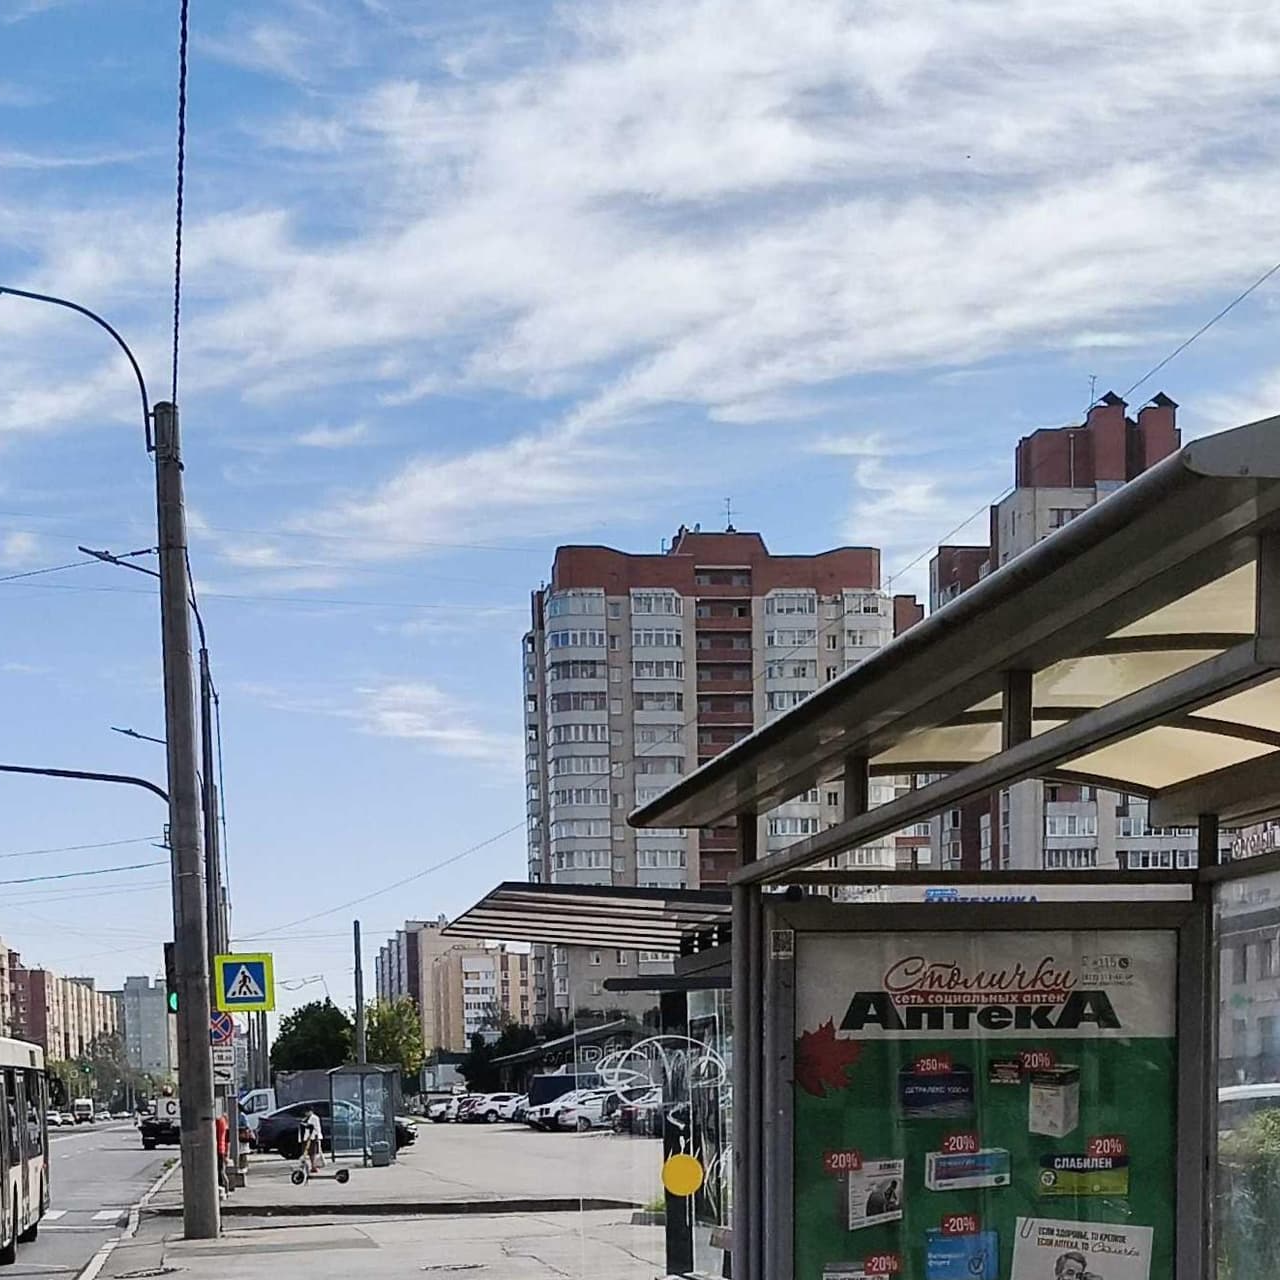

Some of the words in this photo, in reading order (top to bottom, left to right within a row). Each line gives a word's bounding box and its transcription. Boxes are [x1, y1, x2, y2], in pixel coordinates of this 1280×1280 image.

[883, 956, 1078, 990] Столички
[895, 993, 924, 1004] сеть
[927, 993, 1020, 1004] социальных
[1023, 992, 1066, 1003] аптек
[916, 1058, 937, 1072] -250
[944, 1135, 975, 1151] -20%
[1090, 1138, 1122, 1154] -20%
[826, 1153, 858, 1169] -20%
[1054, 1157, 1112, 1169] СЛАБИЛЕН
[944, 1216, 975, 1231] -20%
[867, 1256, 897, 1271] -20%
